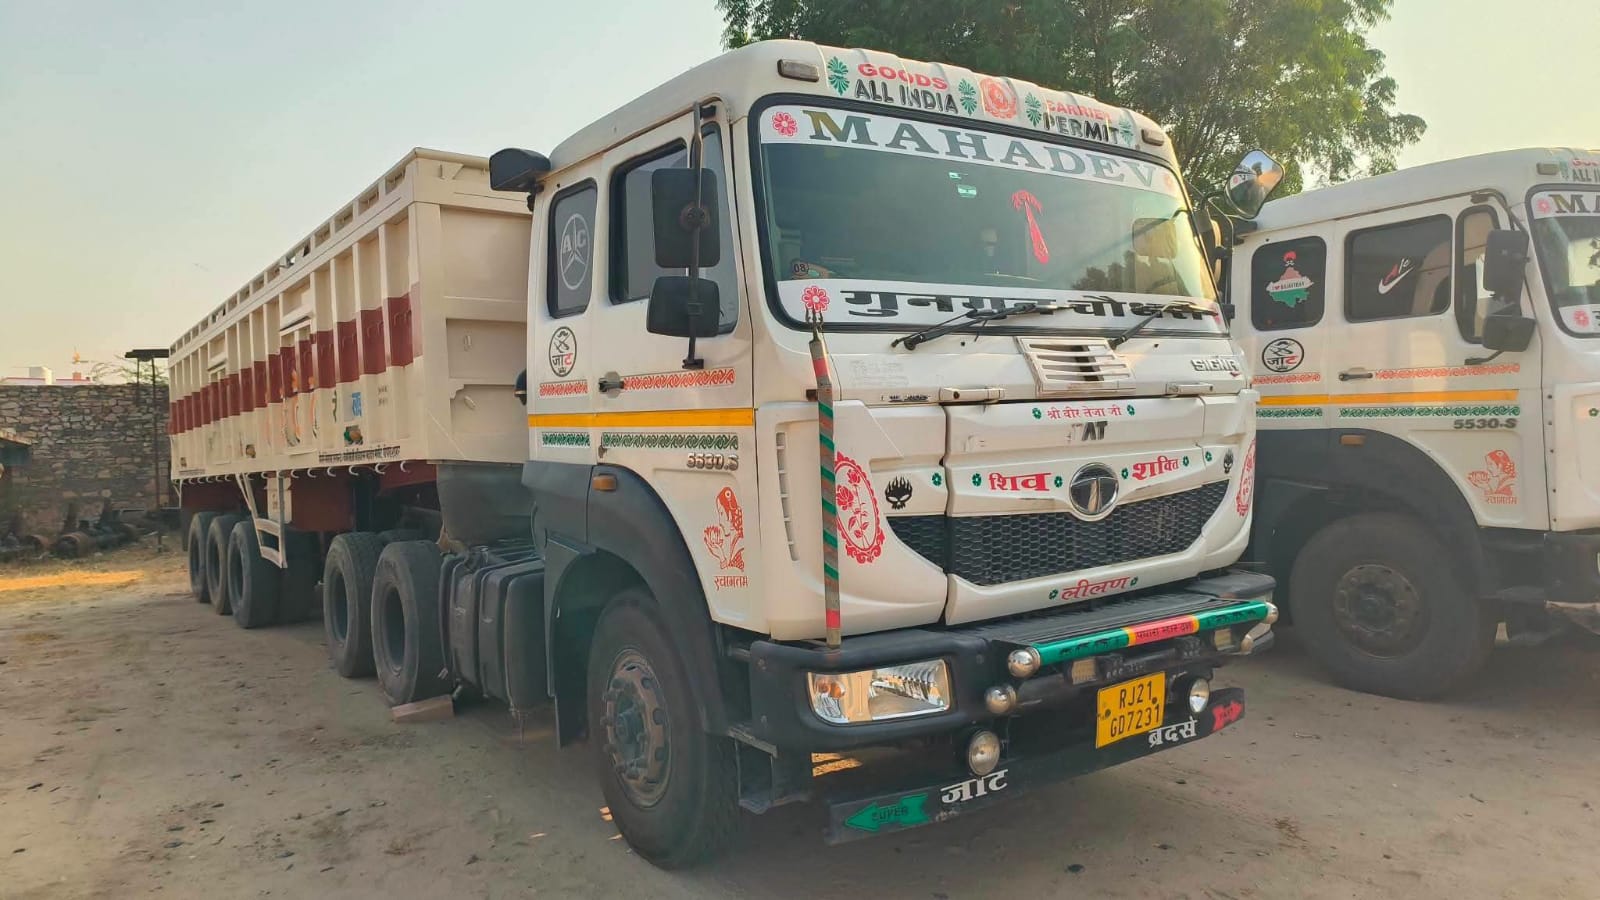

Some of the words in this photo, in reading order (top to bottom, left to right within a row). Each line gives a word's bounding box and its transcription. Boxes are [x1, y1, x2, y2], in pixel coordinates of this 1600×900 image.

[857, 63, 948, 90] GOODS
[855, 79, 894, 103] ALL
[899, 84, 958, 114] INDIA
[1043, 112, 1119, 144] PERMIT
[802, 109, 1156, 187] MAHADEV
[552, 353, 574, 366] जाट
[1267, 355, 1298, 366] जाट
[1047, 406, 1060, 419] श्री
[1063, 406, 1079, 418] वीर
[1082, 405, 1105, 417] तेजा
[1108, 404, 1122, 416] जी
[989, 472, 1051, 491] शिव
[1132, 455, 1180, 481] शक्ति
[1061, 579, 1130, 600] लीलण
[1119, 681, 1153, 709] RJ21
[1110, 703, 1160, 738] GD7231
[939, 769, 1009, 804] जाट
[871, 806, 909, 822] SUPER
